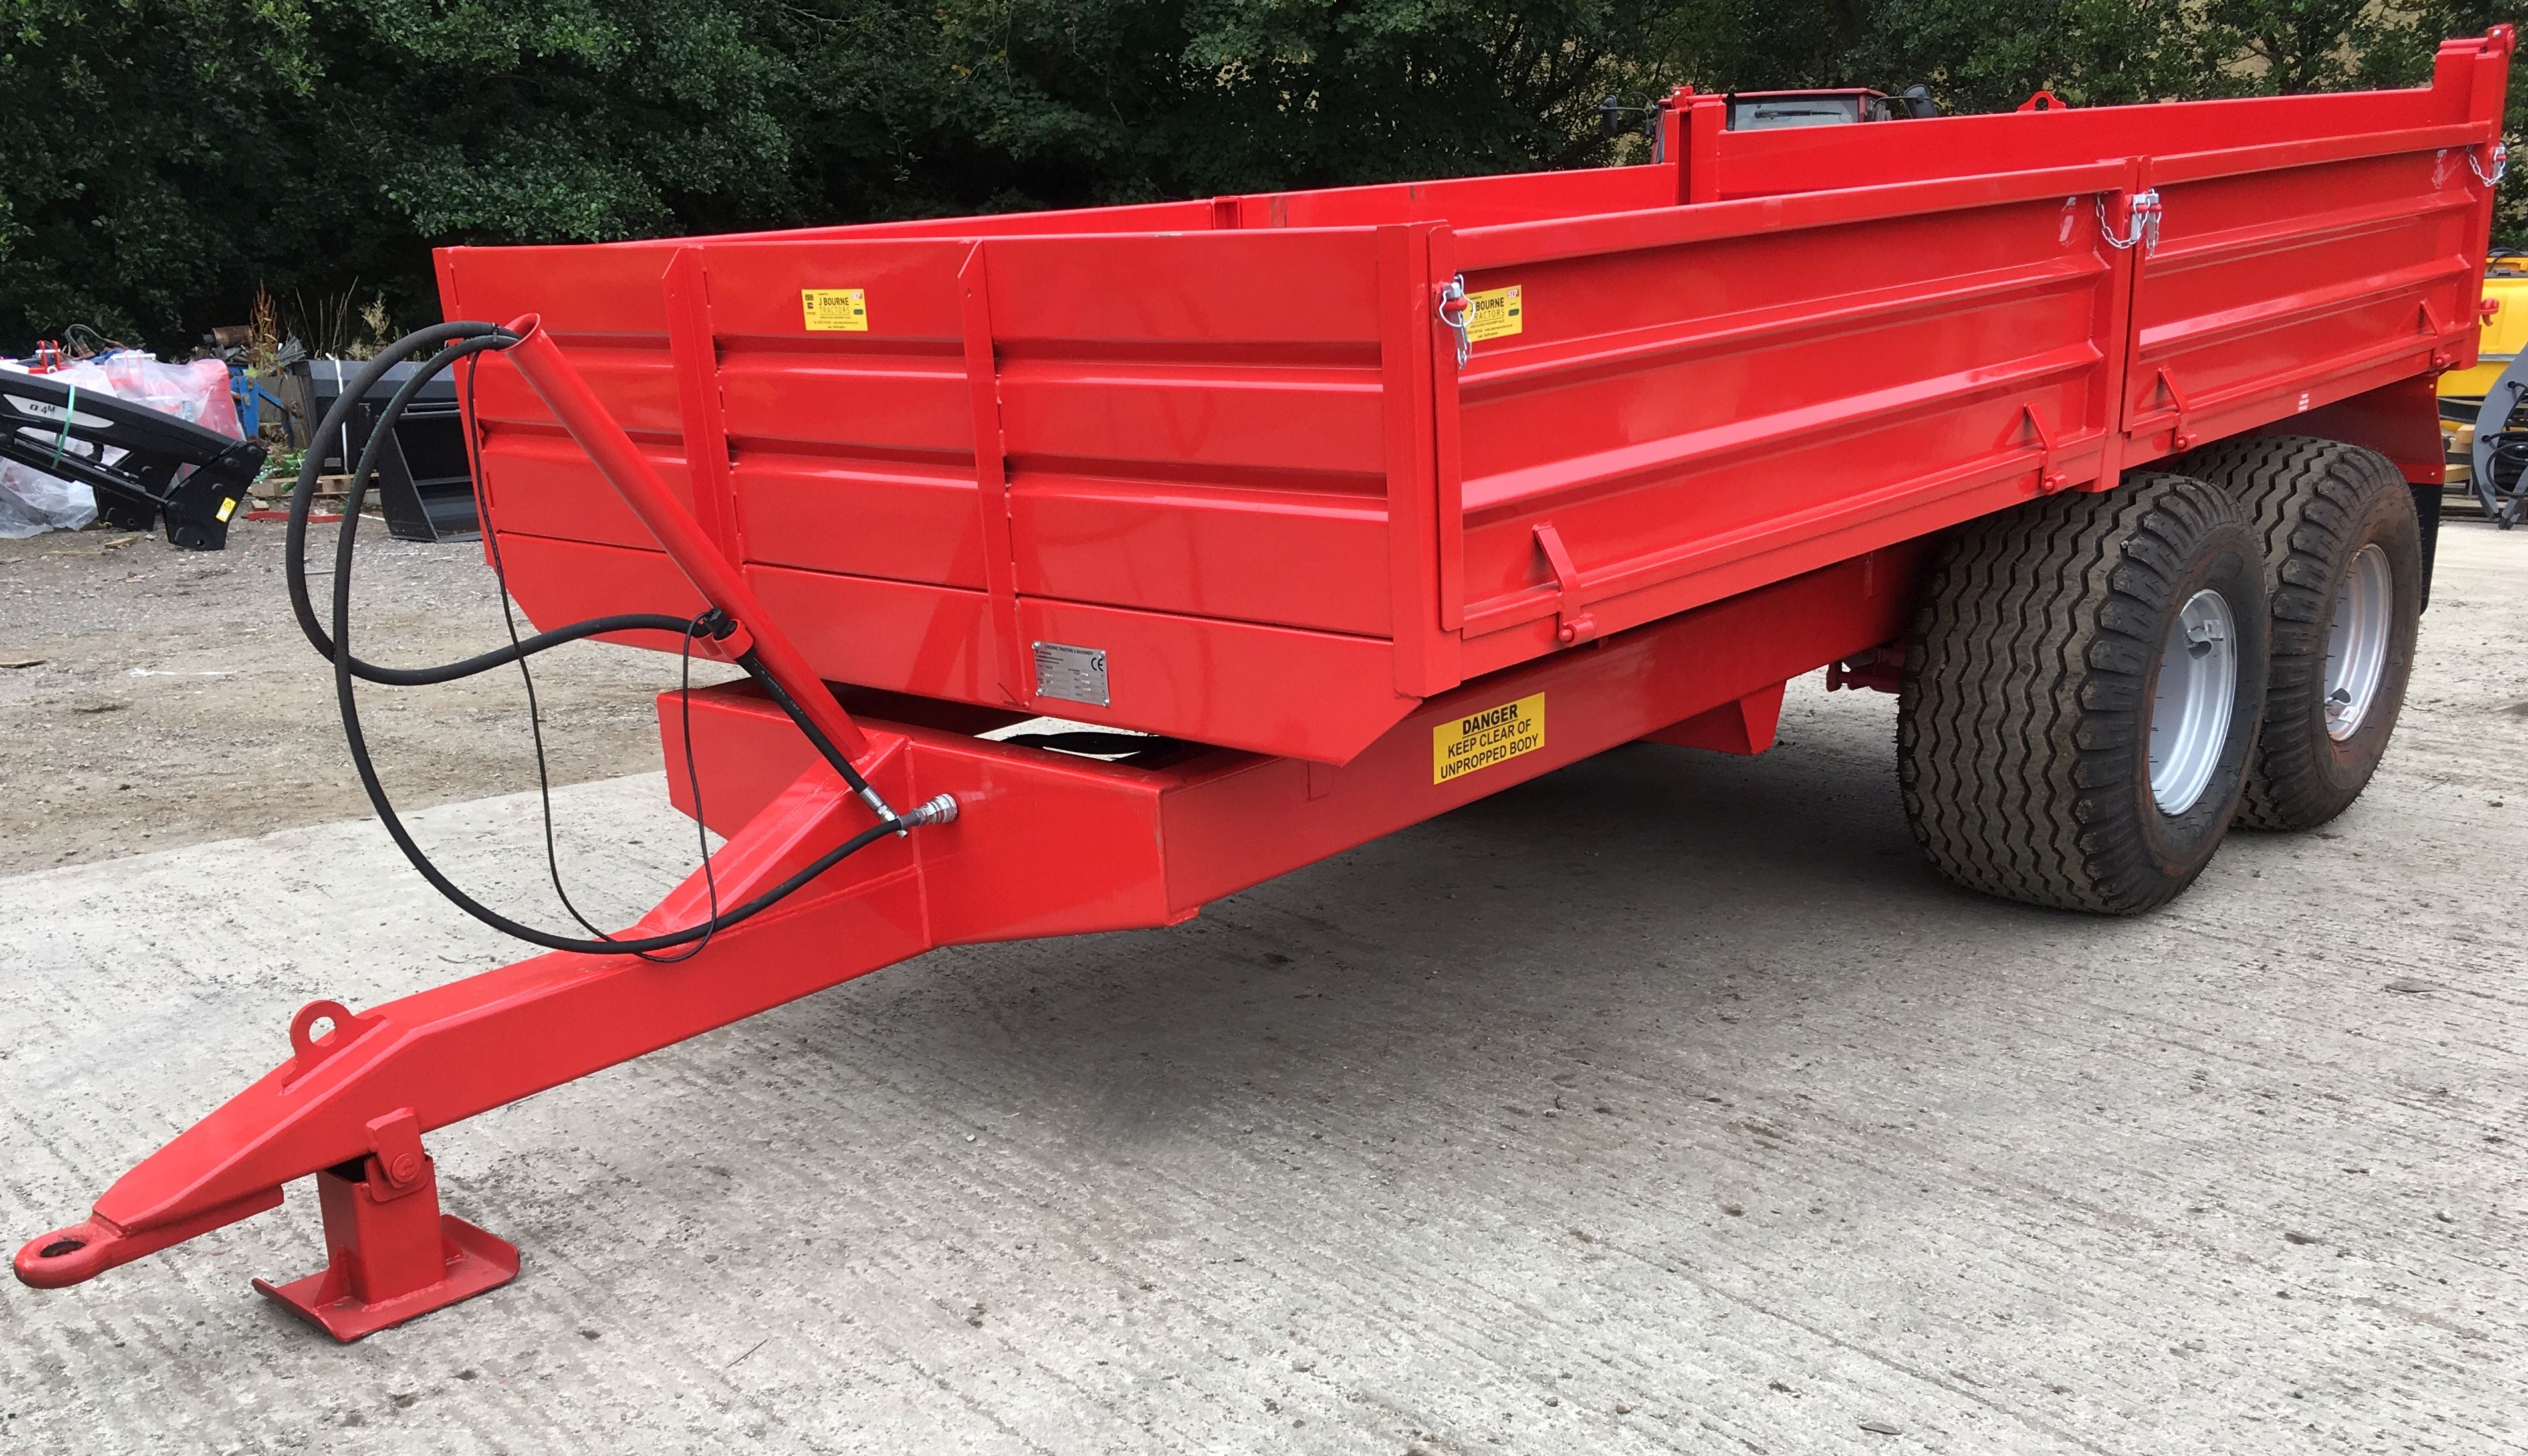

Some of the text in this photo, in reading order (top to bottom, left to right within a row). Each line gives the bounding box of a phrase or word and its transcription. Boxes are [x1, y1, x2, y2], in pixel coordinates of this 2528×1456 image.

[824, 297, 850, 306] BOURNE
[1508, 290, 1518, 298] SIP
[1476, 297, 1504, 311] BOURNE
[1091, 657, 1103, 672] CE
[1462, 704, 1518, 735] DANGER
[1448, 718, 1532, 758] KEEP CLEAR OF
[1440, 734, 1539, 779] UNPROPPED BODY
